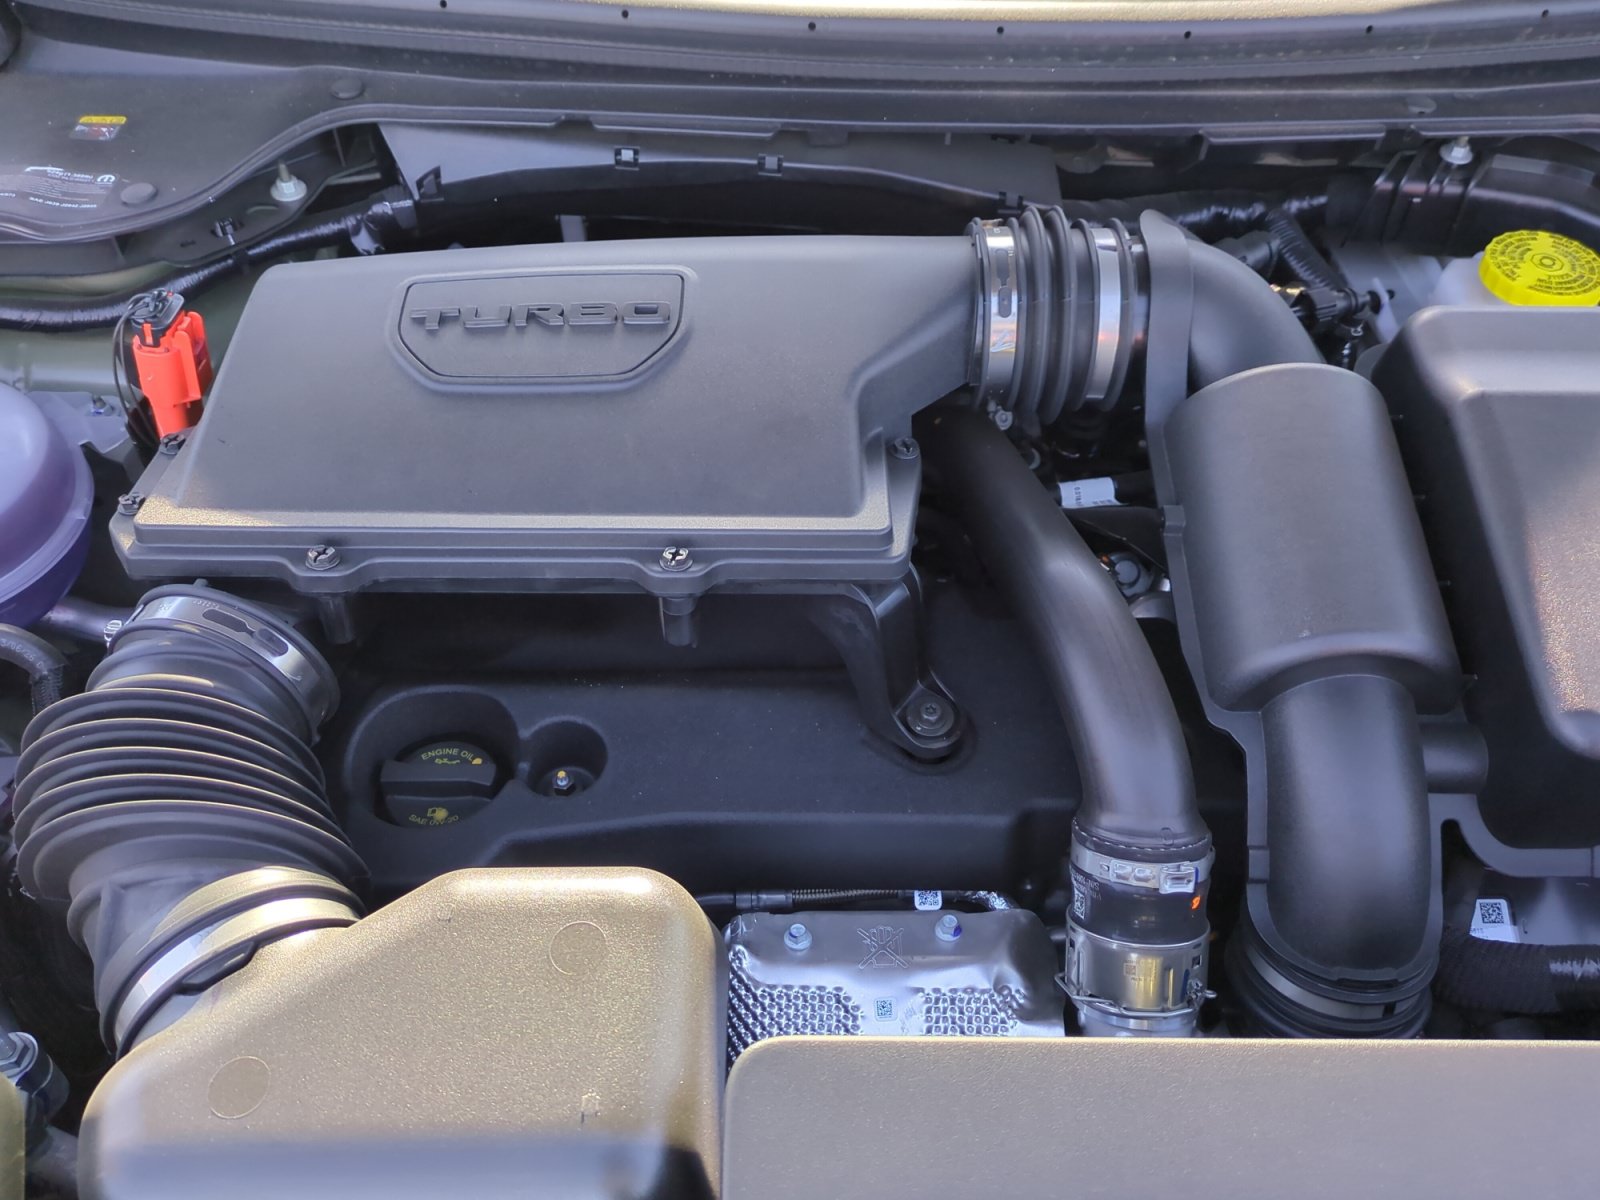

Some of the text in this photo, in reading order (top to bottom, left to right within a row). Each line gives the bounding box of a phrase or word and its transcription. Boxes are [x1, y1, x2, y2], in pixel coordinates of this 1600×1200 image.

[409, 301, 671, 330] TURBO
[421, 748, 475, 762] ENGINE OIL
[408, 814, 428, 825] SAE
